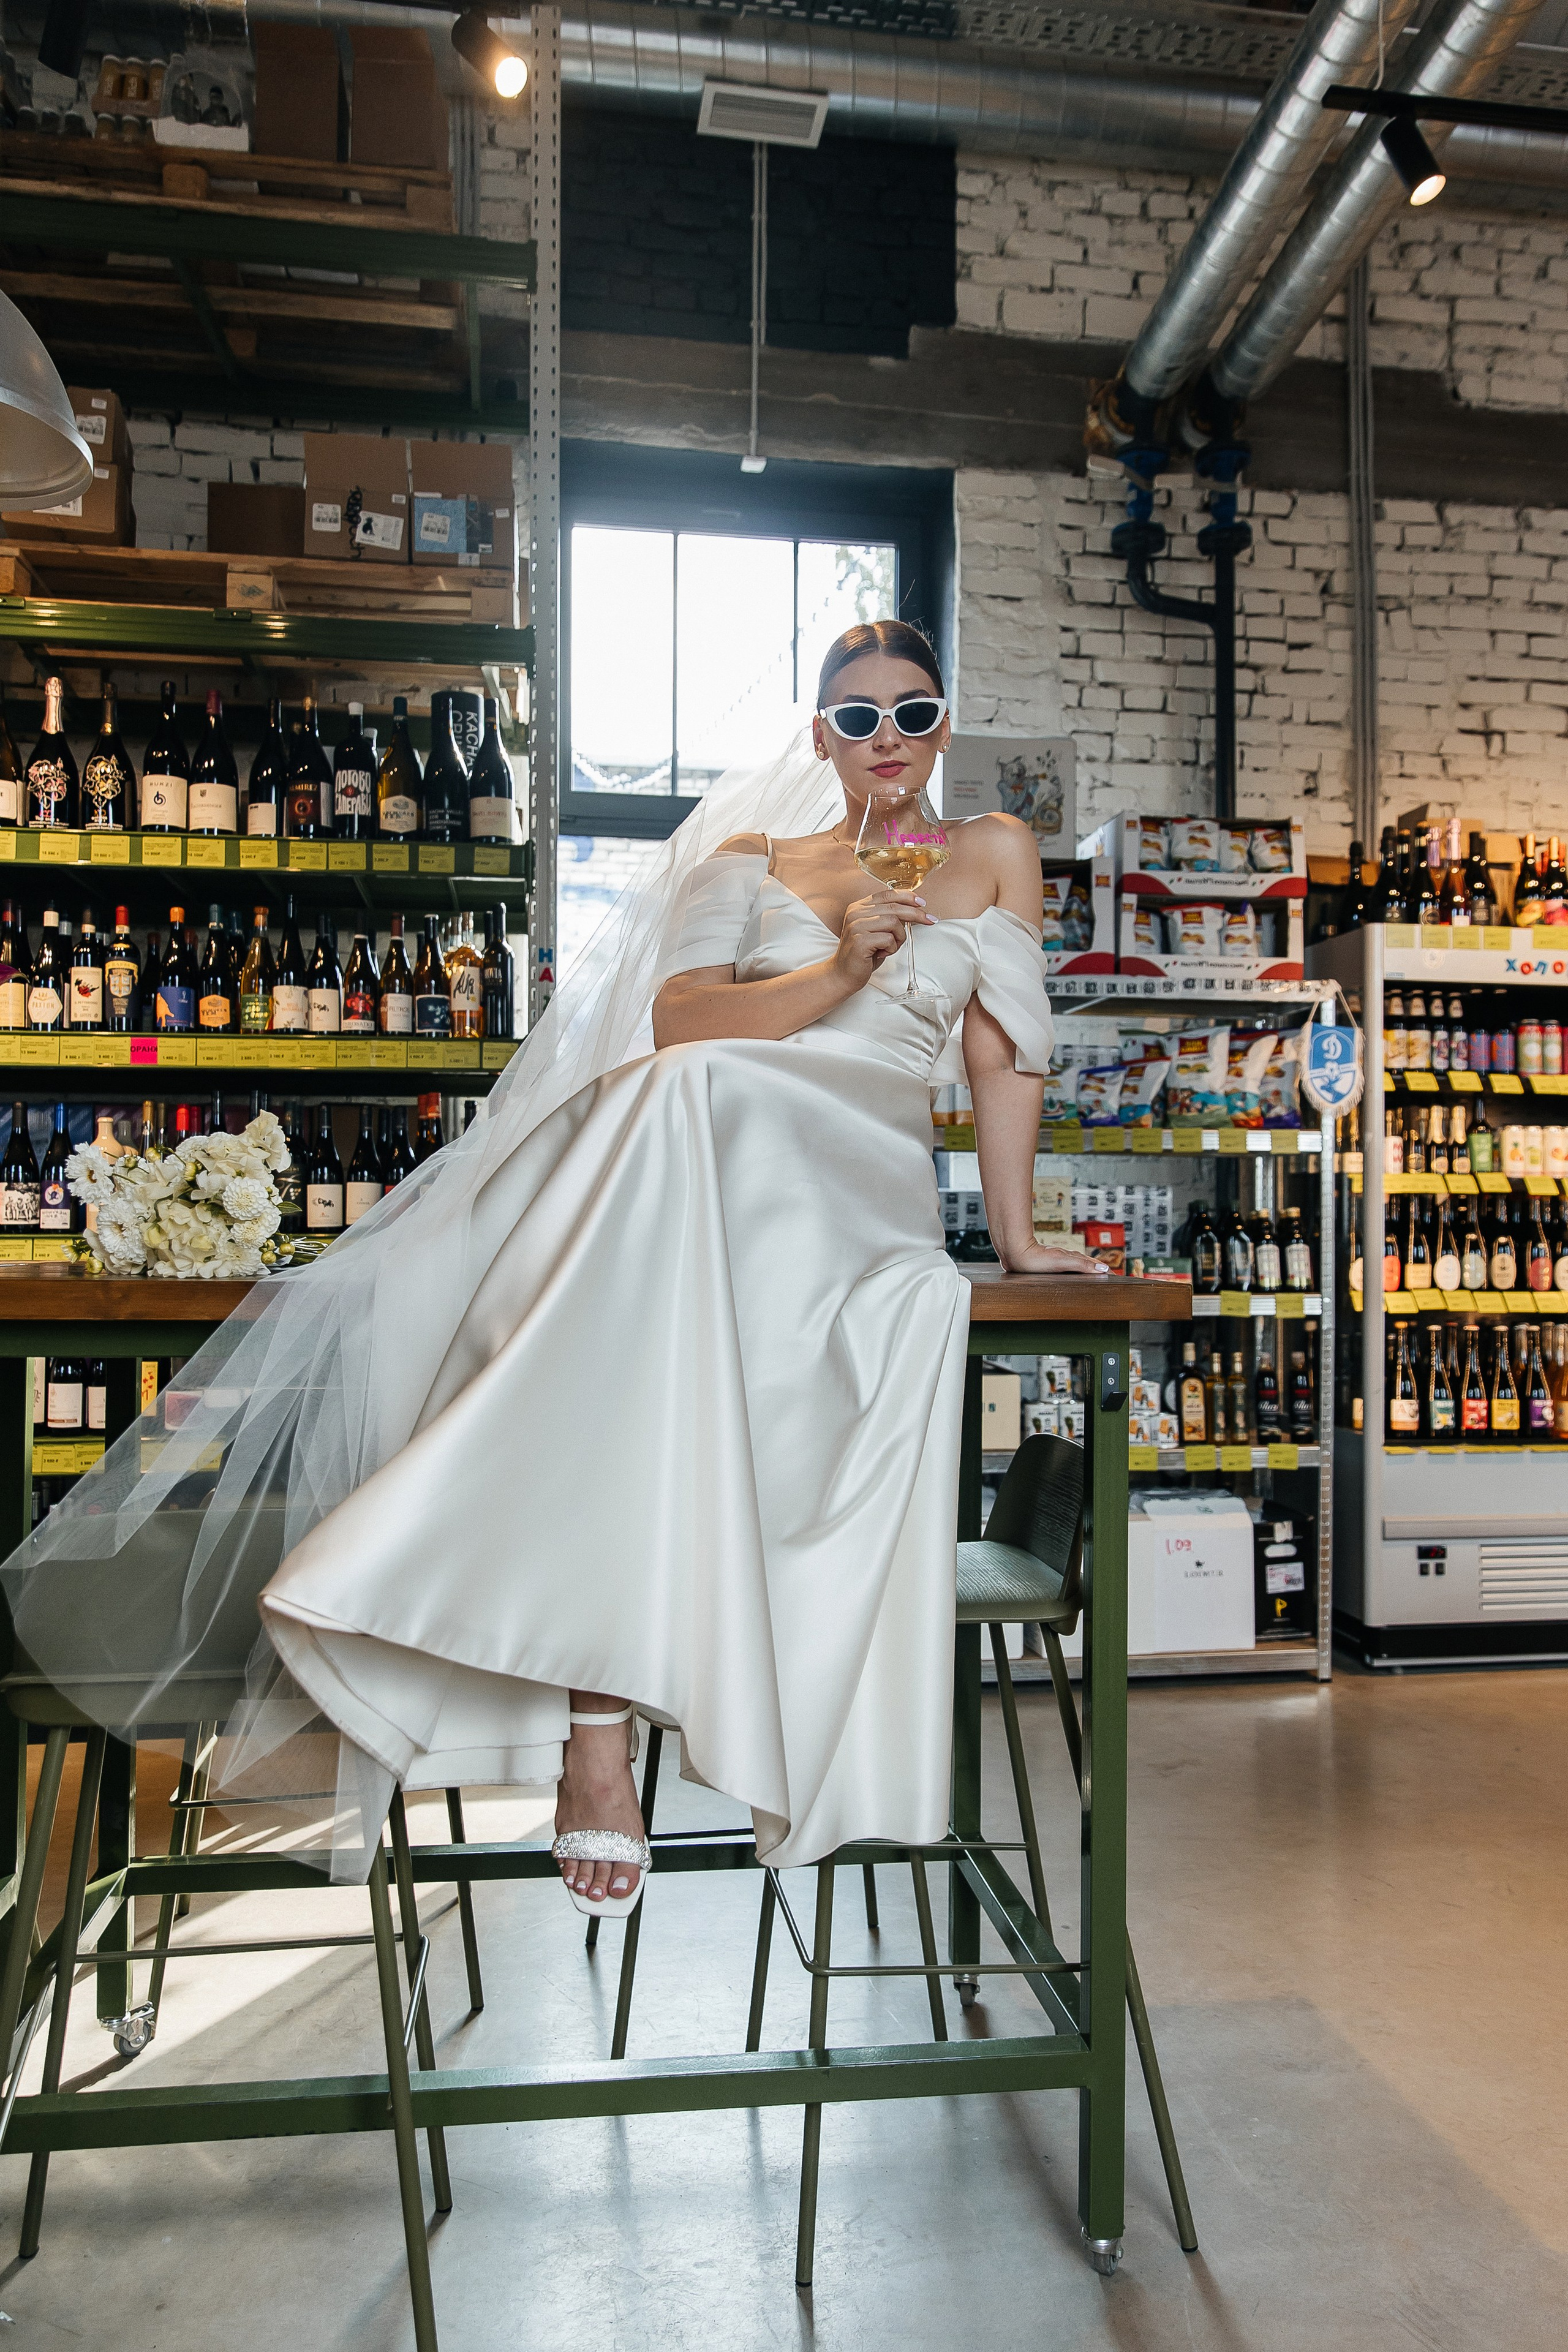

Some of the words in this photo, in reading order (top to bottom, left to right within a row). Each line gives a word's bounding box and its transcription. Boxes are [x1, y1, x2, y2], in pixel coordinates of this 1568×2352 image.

[335, 769, 371, 793] ЛОГОВО
[335, 794, 371, 816] САПЕРАВИ
[1506, 959, 1568, 976] ХОЛО
